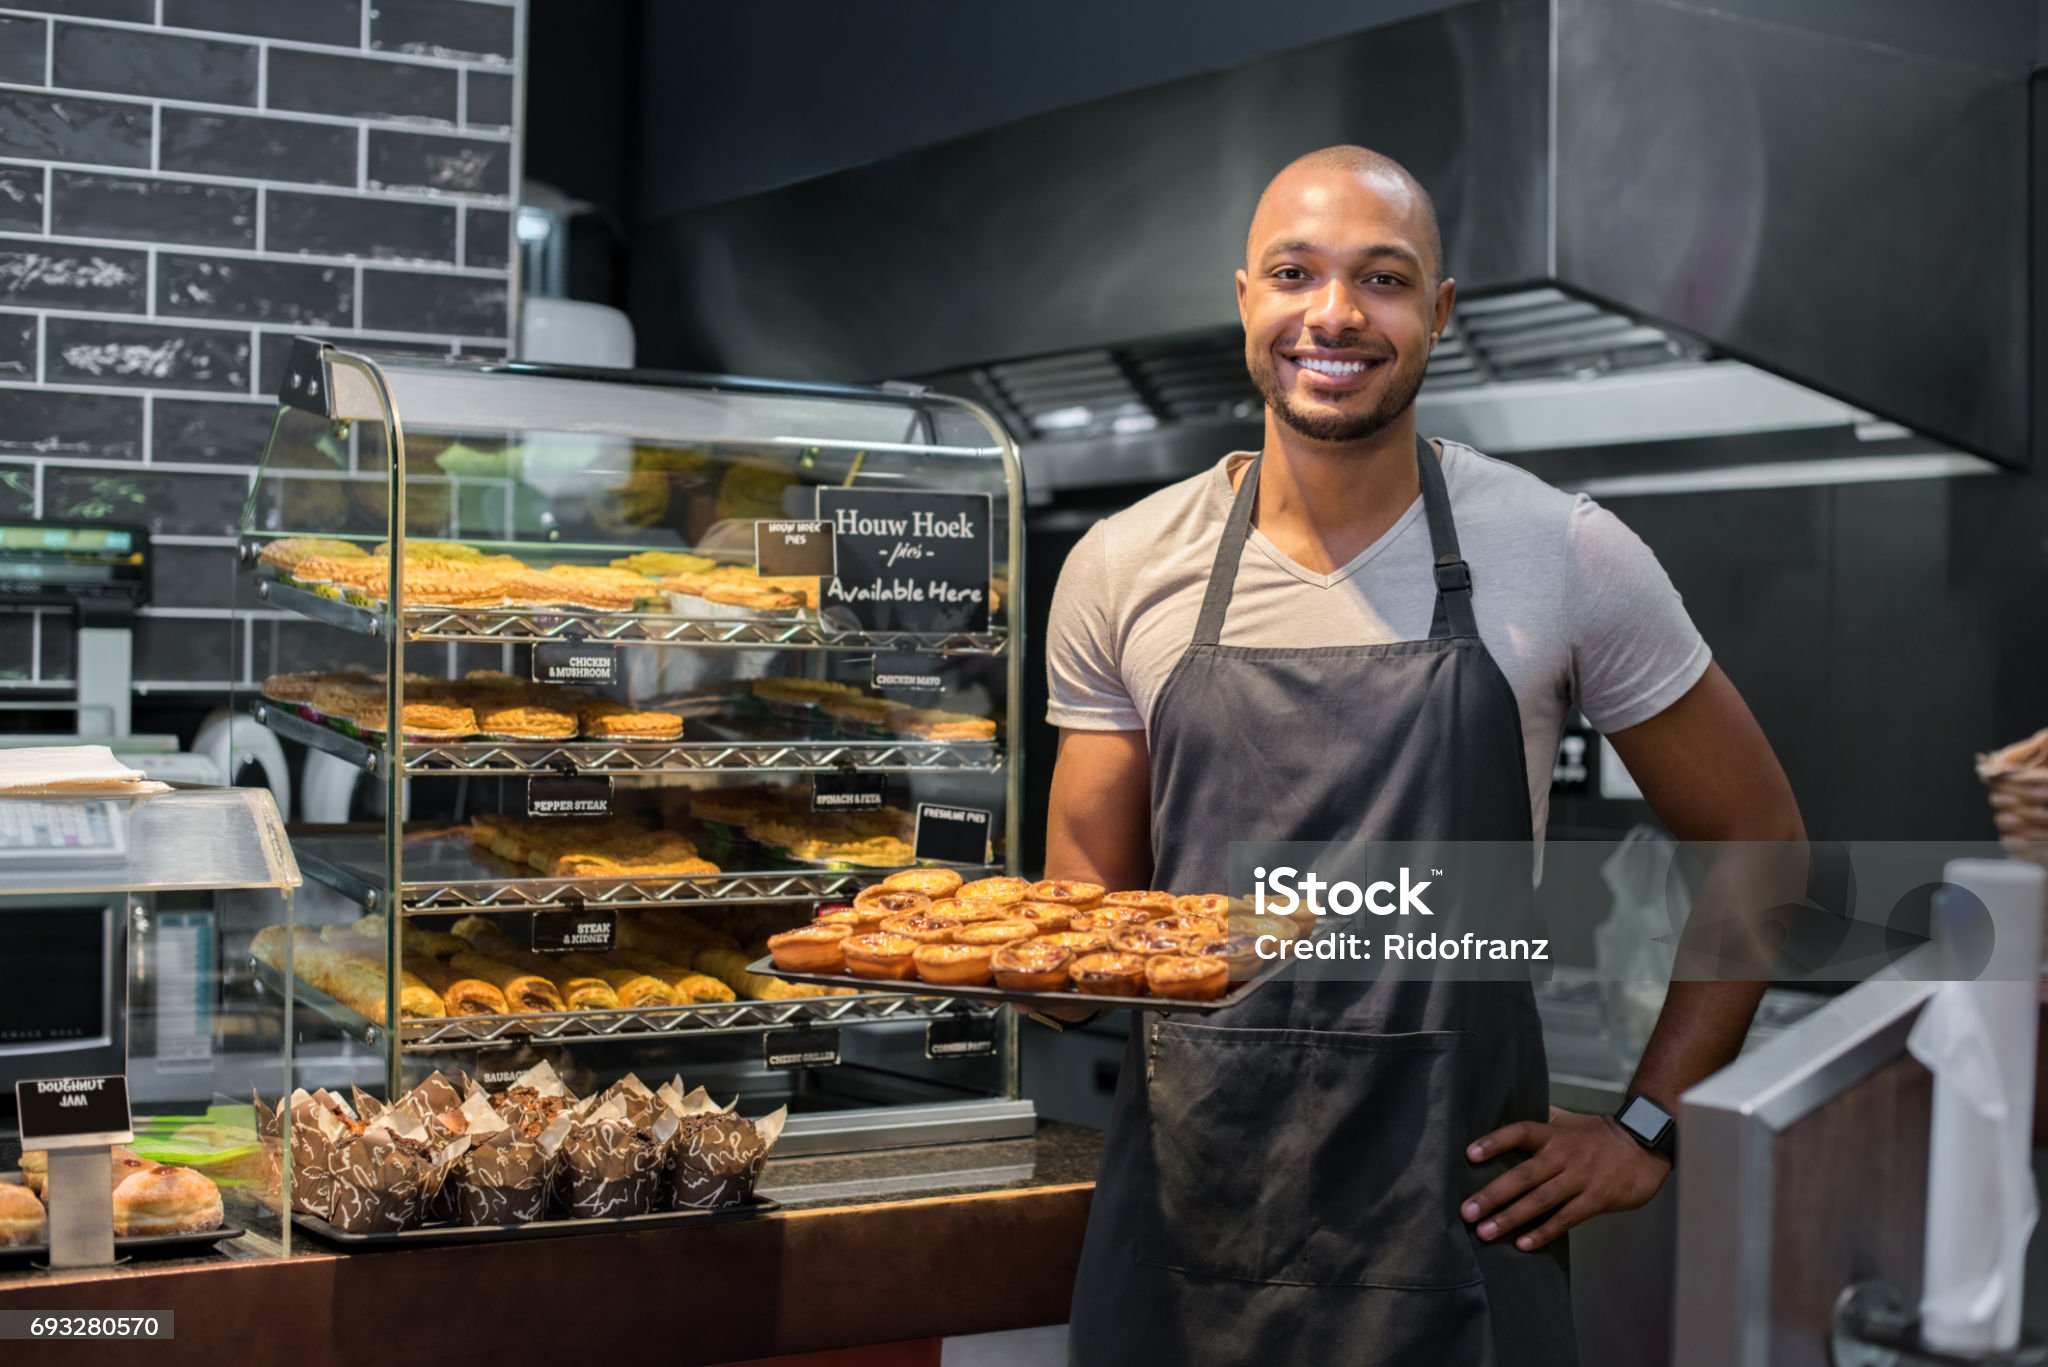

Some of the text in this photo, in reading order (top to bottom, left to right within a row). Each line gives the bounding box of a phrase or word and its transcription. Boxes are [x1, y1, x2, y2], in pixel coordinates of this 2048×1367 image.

[836, 509, 975, 539] Houw Hoek
[784, 534, 807, 545] PIES
[827, 576, 983, 603] Available Here
[569, 656, 611, 668] CHICKEN
[534, 800, 608, 812] PEPPER STEAK
[577, 922, 611, 934] STEAK
[571, 934, 610, 944] KIDNEY
[483, 1070, 526, 1083] SAUSAG
[37, 1078, 105, 1094] DOUGHNUT
